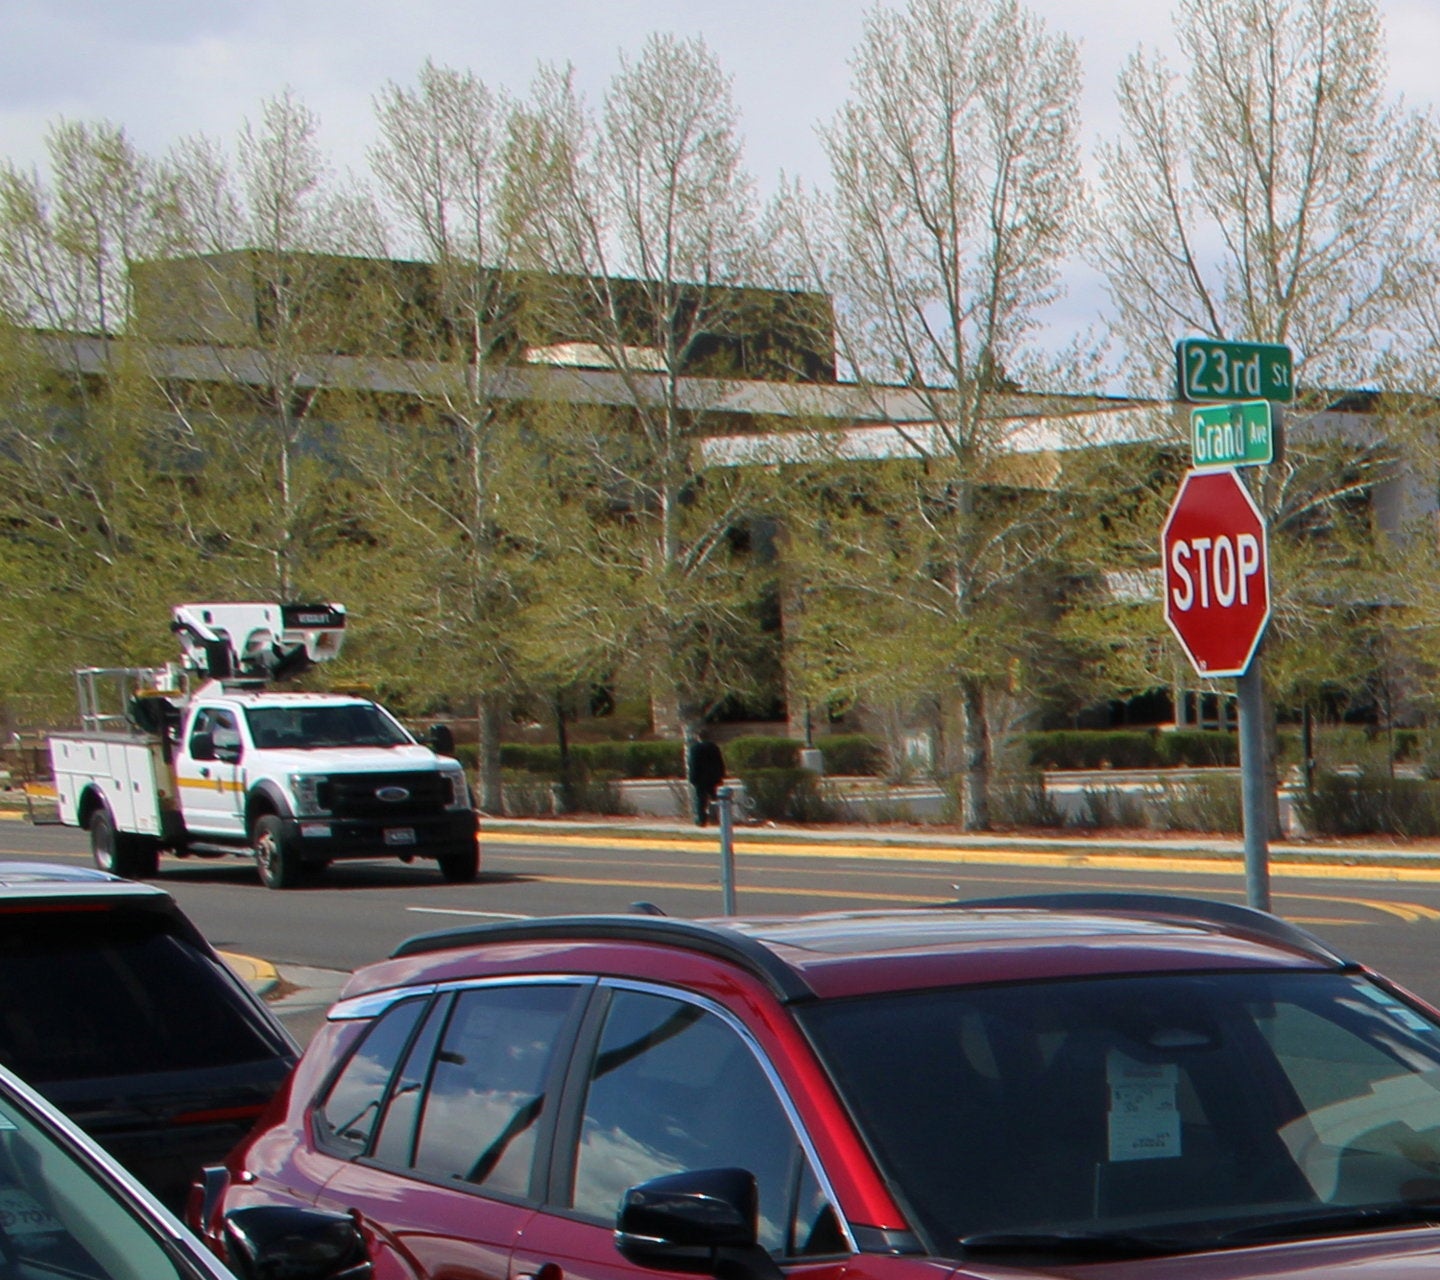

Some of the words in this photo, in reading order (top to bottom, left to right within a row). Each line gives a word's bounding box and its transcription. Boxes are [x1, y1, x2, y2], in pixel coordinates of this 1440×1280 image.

[1189, 347, 1261, 396] 23rd
[1271, 360, 1289, 388] St
[1194, 414, 1245, 461] Grand
[1250, 421, 1267, 445] Ave
[1171, 533, 1259, 612] STOP
